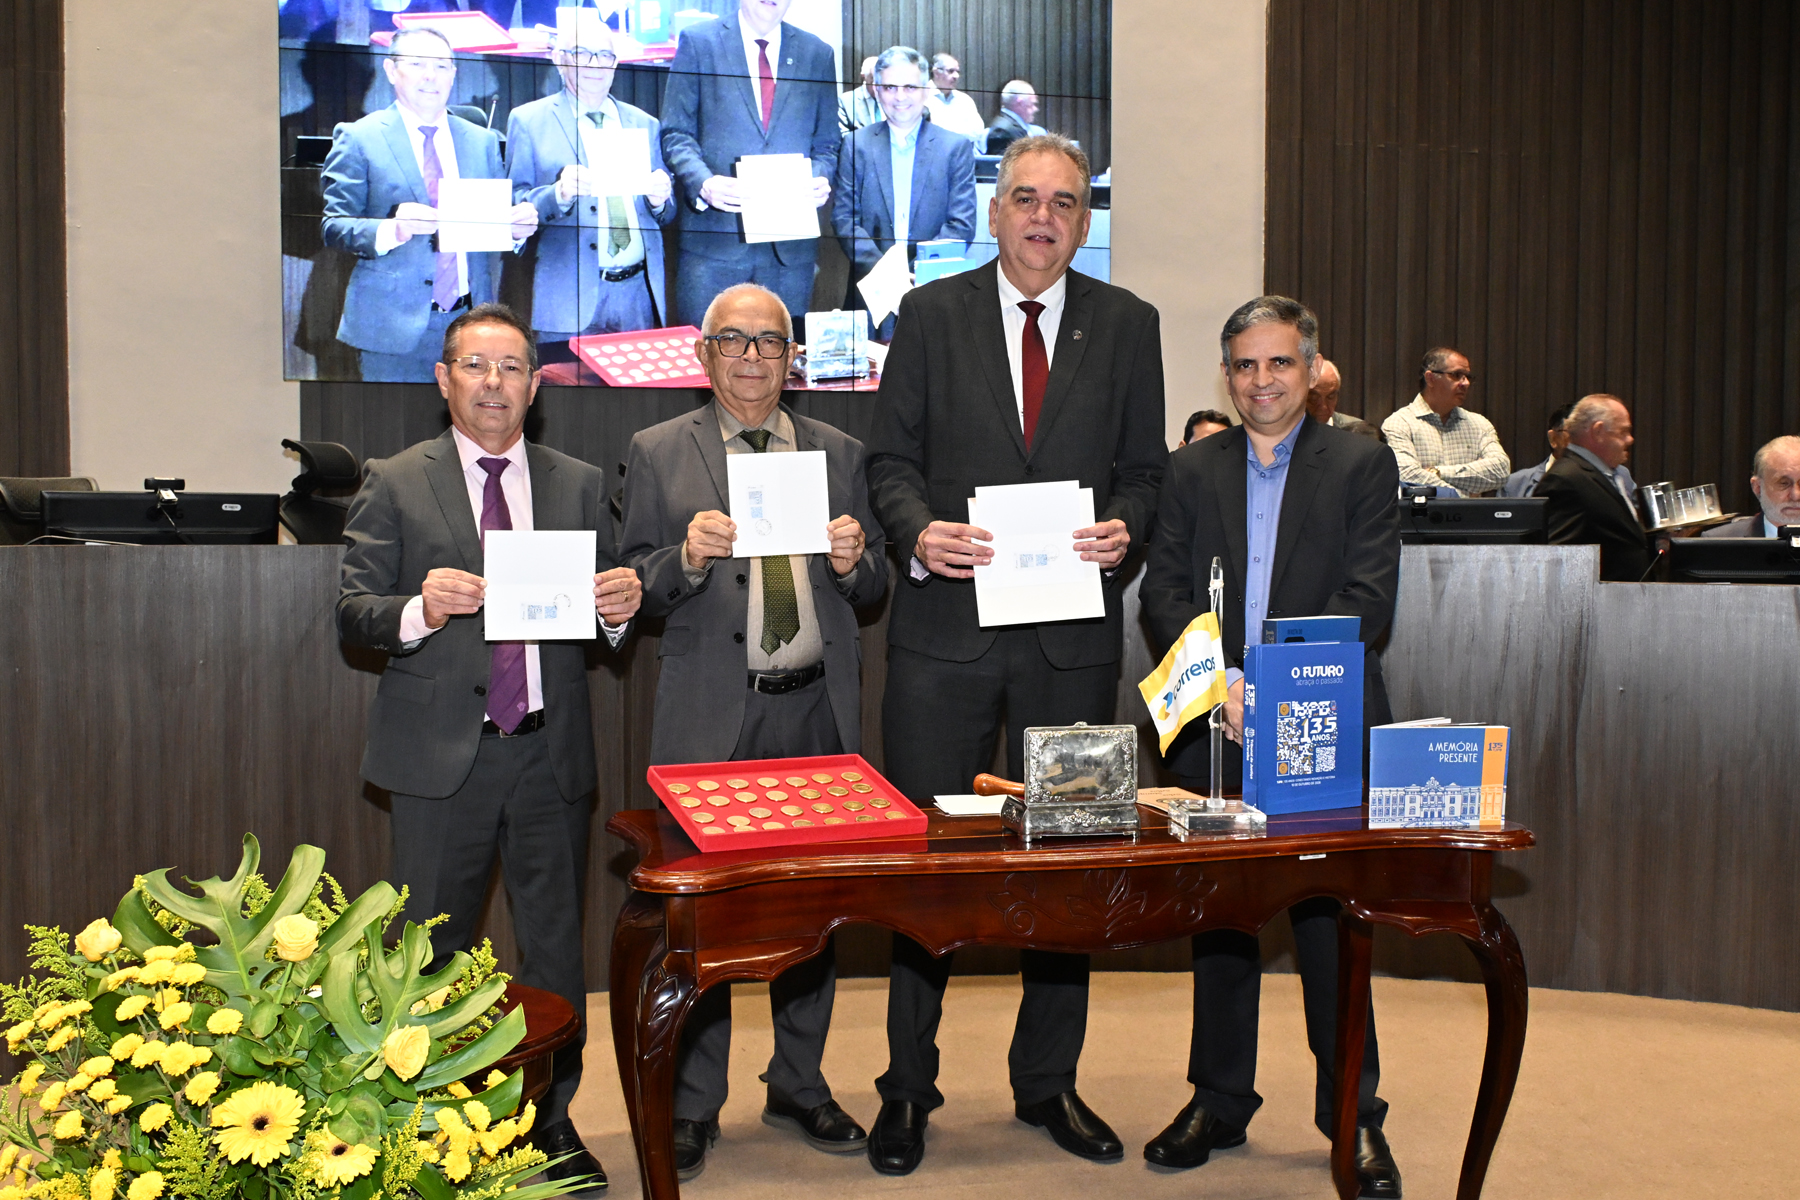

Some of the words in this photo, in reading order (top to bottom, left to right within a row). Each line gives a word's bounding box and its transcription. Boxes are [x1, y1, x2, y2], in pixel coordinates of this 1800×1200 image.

[1446, 512, 1462, 522] LG
[1291, 667, 1300, 678] O
[1303, 665, 1344, 678] FUTURO
[1321, 677, 1343, 685] passado
[1245, 682, 1255, 707] 135
[1301, 717, 1337, 743] 135
[1311, 734, 1330, 742] ANOS
[1428, 742, 1434, 751] A
[1435, 741, 1478, 751] MEMÓRIA
[1487, 742, 1503, 751] 135
[1439, 753, 1478, 763] PRESENTE
